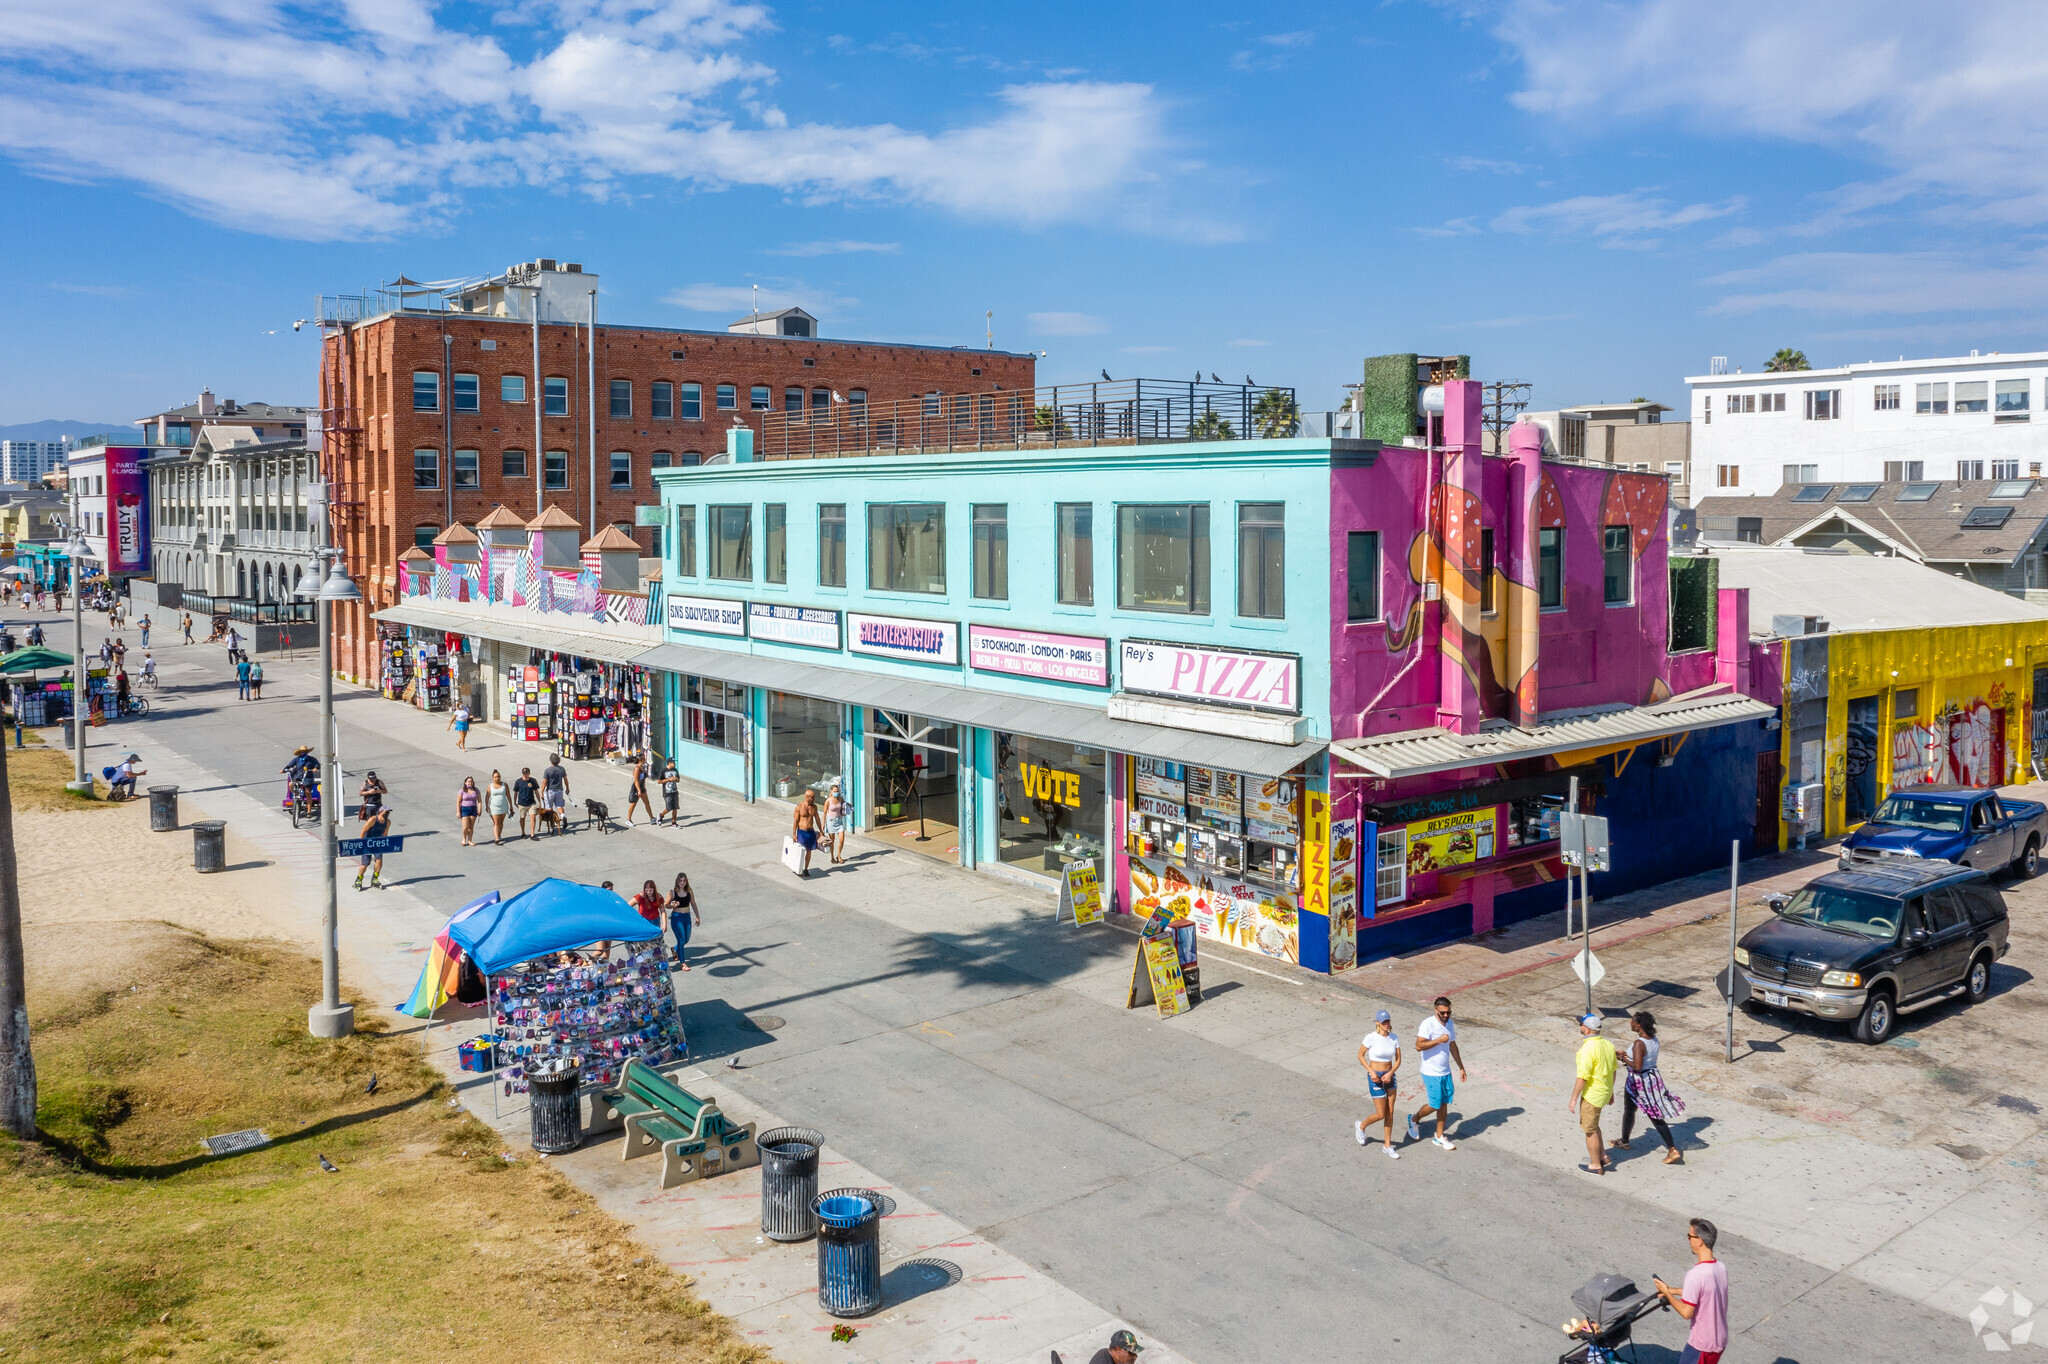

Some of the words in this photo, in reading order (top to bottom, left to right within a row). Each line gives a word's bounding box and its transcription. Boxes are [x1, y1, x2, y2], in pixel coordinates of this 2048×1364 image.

[119, 509, 131, 555] TRULY
[670, 604, 684, 619] SNS
[684, 606, 720, 623] SOUVENIR
[722, 609, 742, 625] SHOP
[750, 603, 771, 616] APPAREL
[773, 605, 799, 620] FOOTWEAR
[801, 608, 837, 624] ACCESSORIES
[751, 618, 782, 636] QUALITY
[785, 622, 837, 643] GUARANTEED
[859, 621, 943, 654] SNEAKERSNSTUFF
[981, 638, 1026, 654] STOCKHOLM
[1031, 644, 1064, 659] LONDON
[1069, 649, 1093, 663] PARIS
[1125, 646, 1154, 663] Rey's
[975, 653, 1000, 668] BERLIN
[1003, 657, 1022, 671] NEW
[1022, 659, 1044, 674] YORK
[1048, 664, 1064, 677] LOS
[1065, 665, 1100, 681] ANGELES
[1168, 651, 1292, 706] PIZZA
[1020, 762, 1080, 808] VOTE
[1139, 797, 1154, 812] HOT
[1156, 801, 1179, 818] DOGS
[1332, 821, 1345, 834] FISH
[1338, 824, 1355, 839] CHIPS
[1427, 818, 1450, 832] REY'S
[1451, 814, 1474, 826] PIZZA
[341, 841, 363, 850] Wave
[366, 838, 390, 848] Crest
[1310, 798, 1324, 909] PIZZA
[1231, 885, 1246, 894] SOFT
[1235, 891, 1255, 900] SERVE
